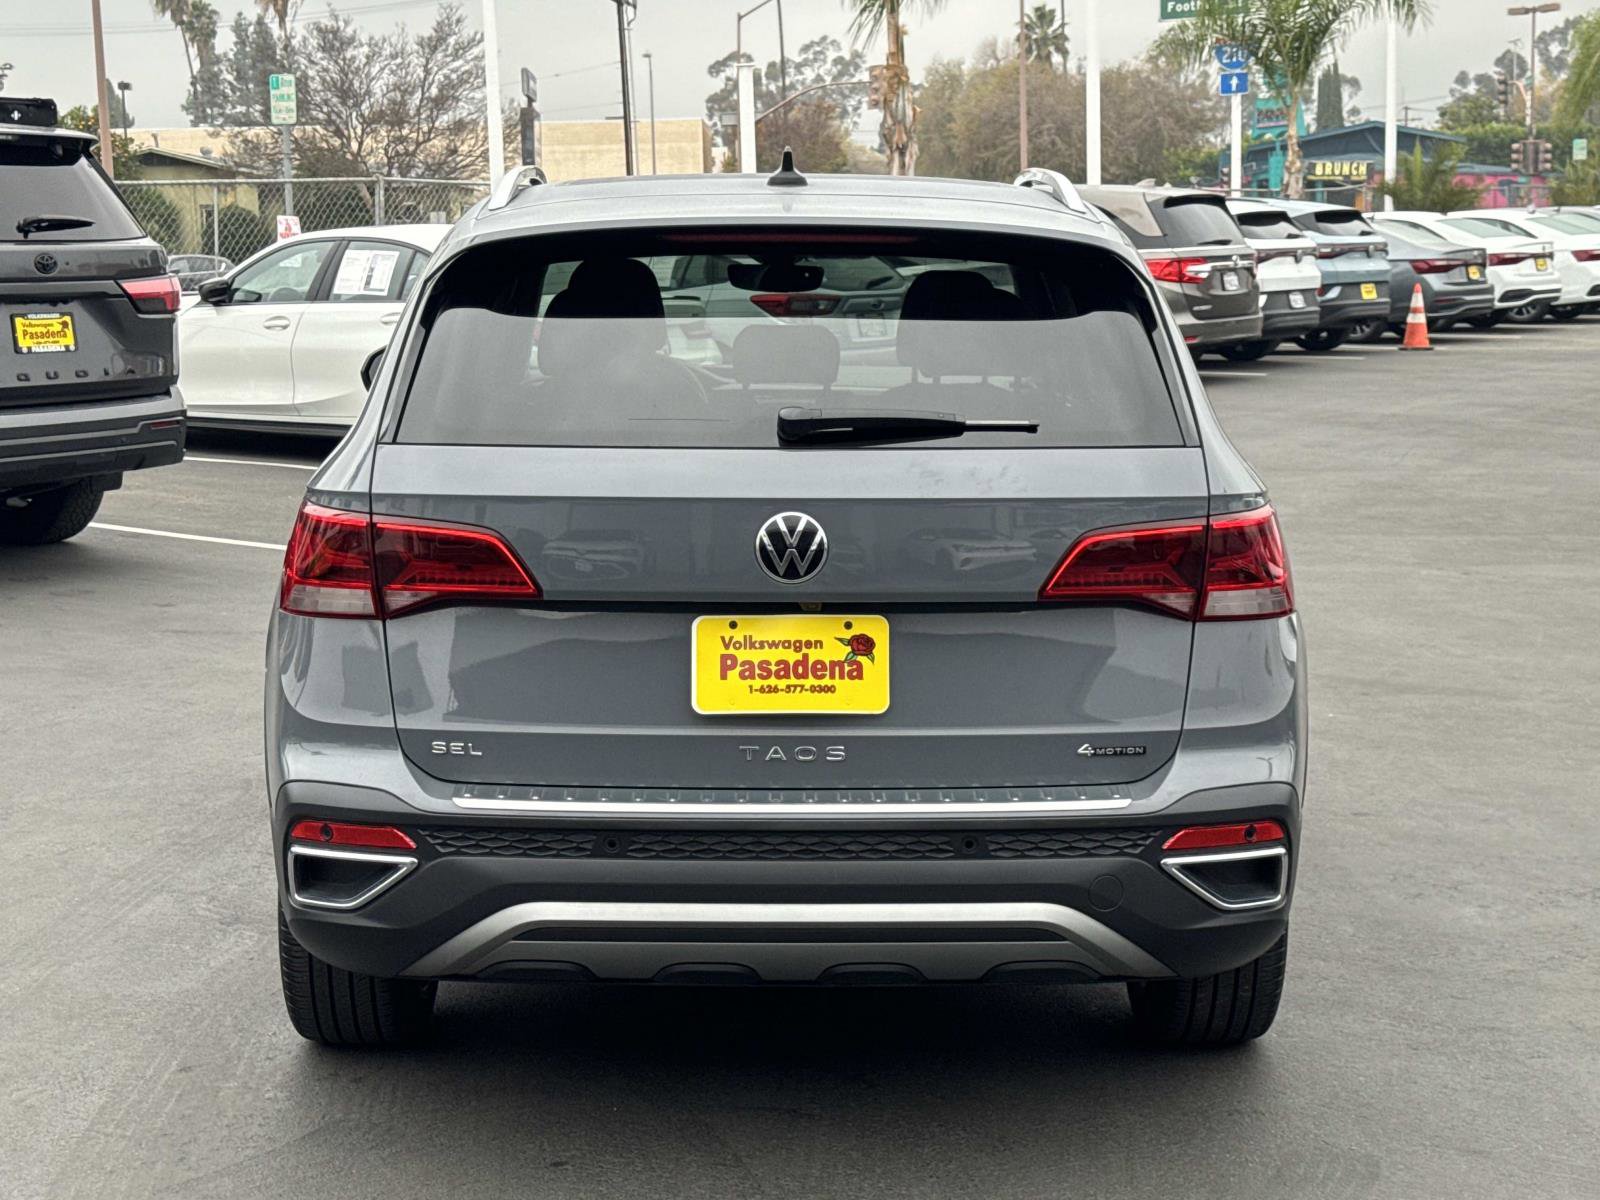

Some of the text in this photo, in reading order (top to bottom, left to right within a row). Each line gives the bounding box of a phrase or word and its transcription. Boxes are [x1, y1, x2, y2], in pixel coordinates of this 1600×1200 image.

[1315, 162, 1367, 176] BRUNCH
[22, 329, 68, 340] Pasadena
[720, 635, 824, 653] Volkswagen
[719, 653, 865, 681] Pasadena
[748, 684, 837, 695] 1-626-577-0300
[431, 741, 483, 756] SEL
[739, 745, 847, 762] TAOS
[1077, 743, 1144, 757] 4MOTION
